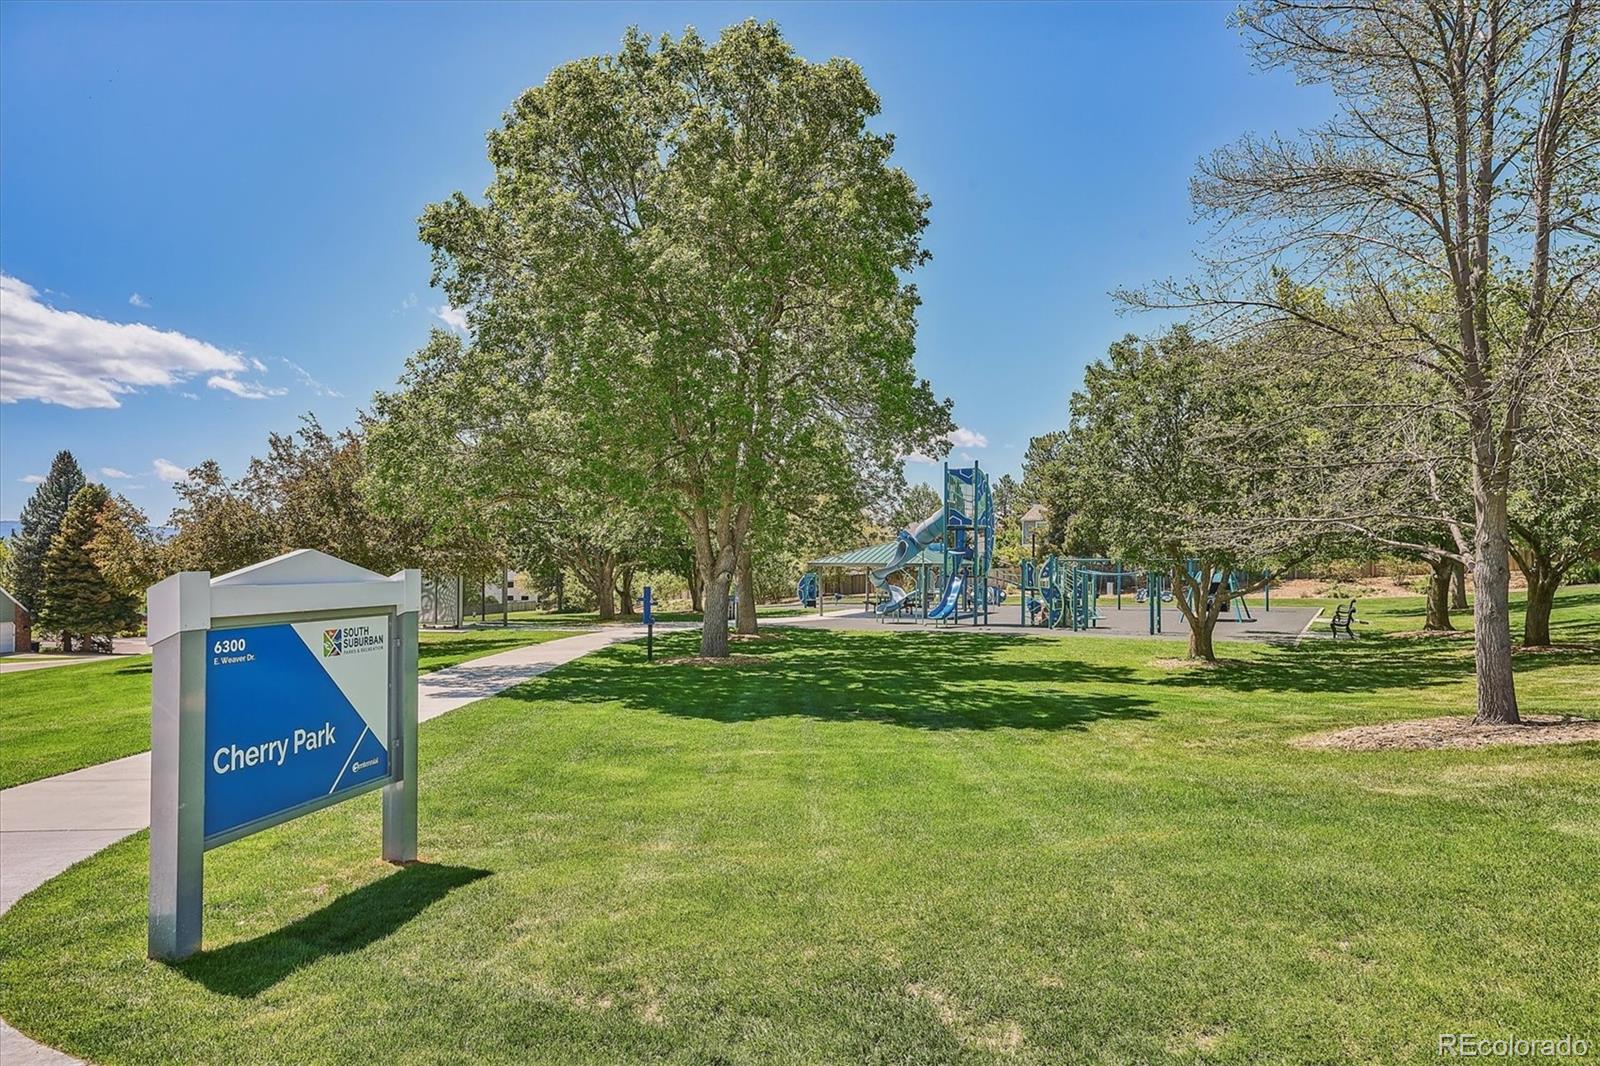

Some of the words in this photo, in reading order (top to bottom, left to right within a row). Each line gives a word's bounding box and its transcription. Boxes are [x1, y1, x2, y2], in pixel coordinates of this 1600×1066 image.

[343, 626, 369, 637] SOUTH
[214, 638, 246, 654] 6300
[343, 634, 383, 648] SUBURBAN
[221, 655, 246, 665] Weaver
[213, 737, 289, 775] Cherry
[294, 722, 336, 754] Park
